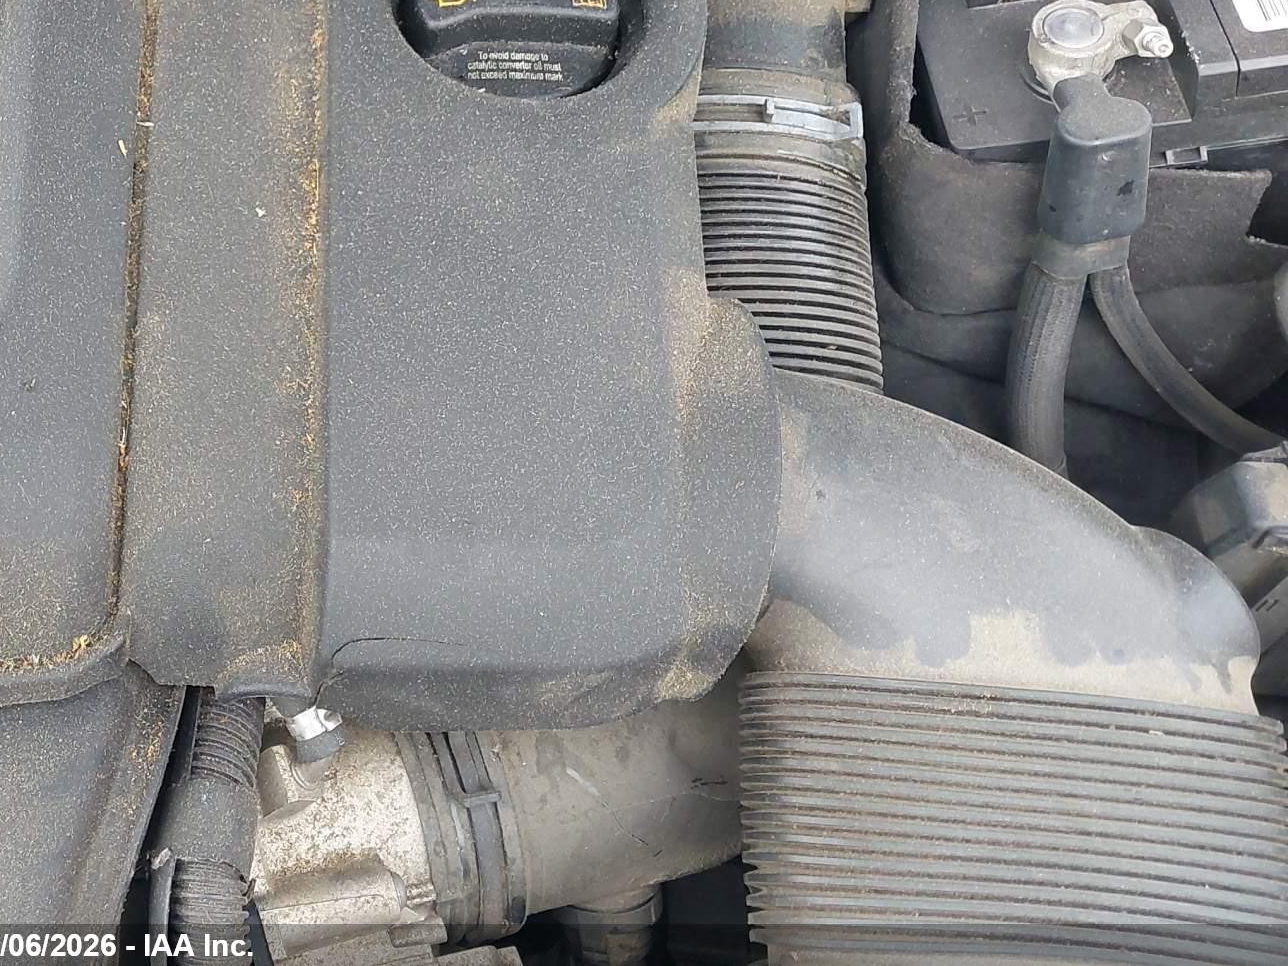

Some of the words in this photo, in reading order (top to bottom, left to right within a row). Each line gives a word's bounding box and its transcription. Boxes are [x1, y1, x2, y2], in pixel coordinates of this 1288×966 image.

[478, 51, 488, 60] To
[489, 51, 509, 60] avoid
[511, 51, 539, 62] damage
[541, 52, 549, 61] to
[467, 60, 498, 71] catalytic
[533, 61, 543, 71] oil
[543, 62, 562, 72] must
[467, 70, 480, 80] not
[481, 70, 508, 80] exceed
[508, 71, 544, 80] maximum
[544, 71, 564, 82] mark.
